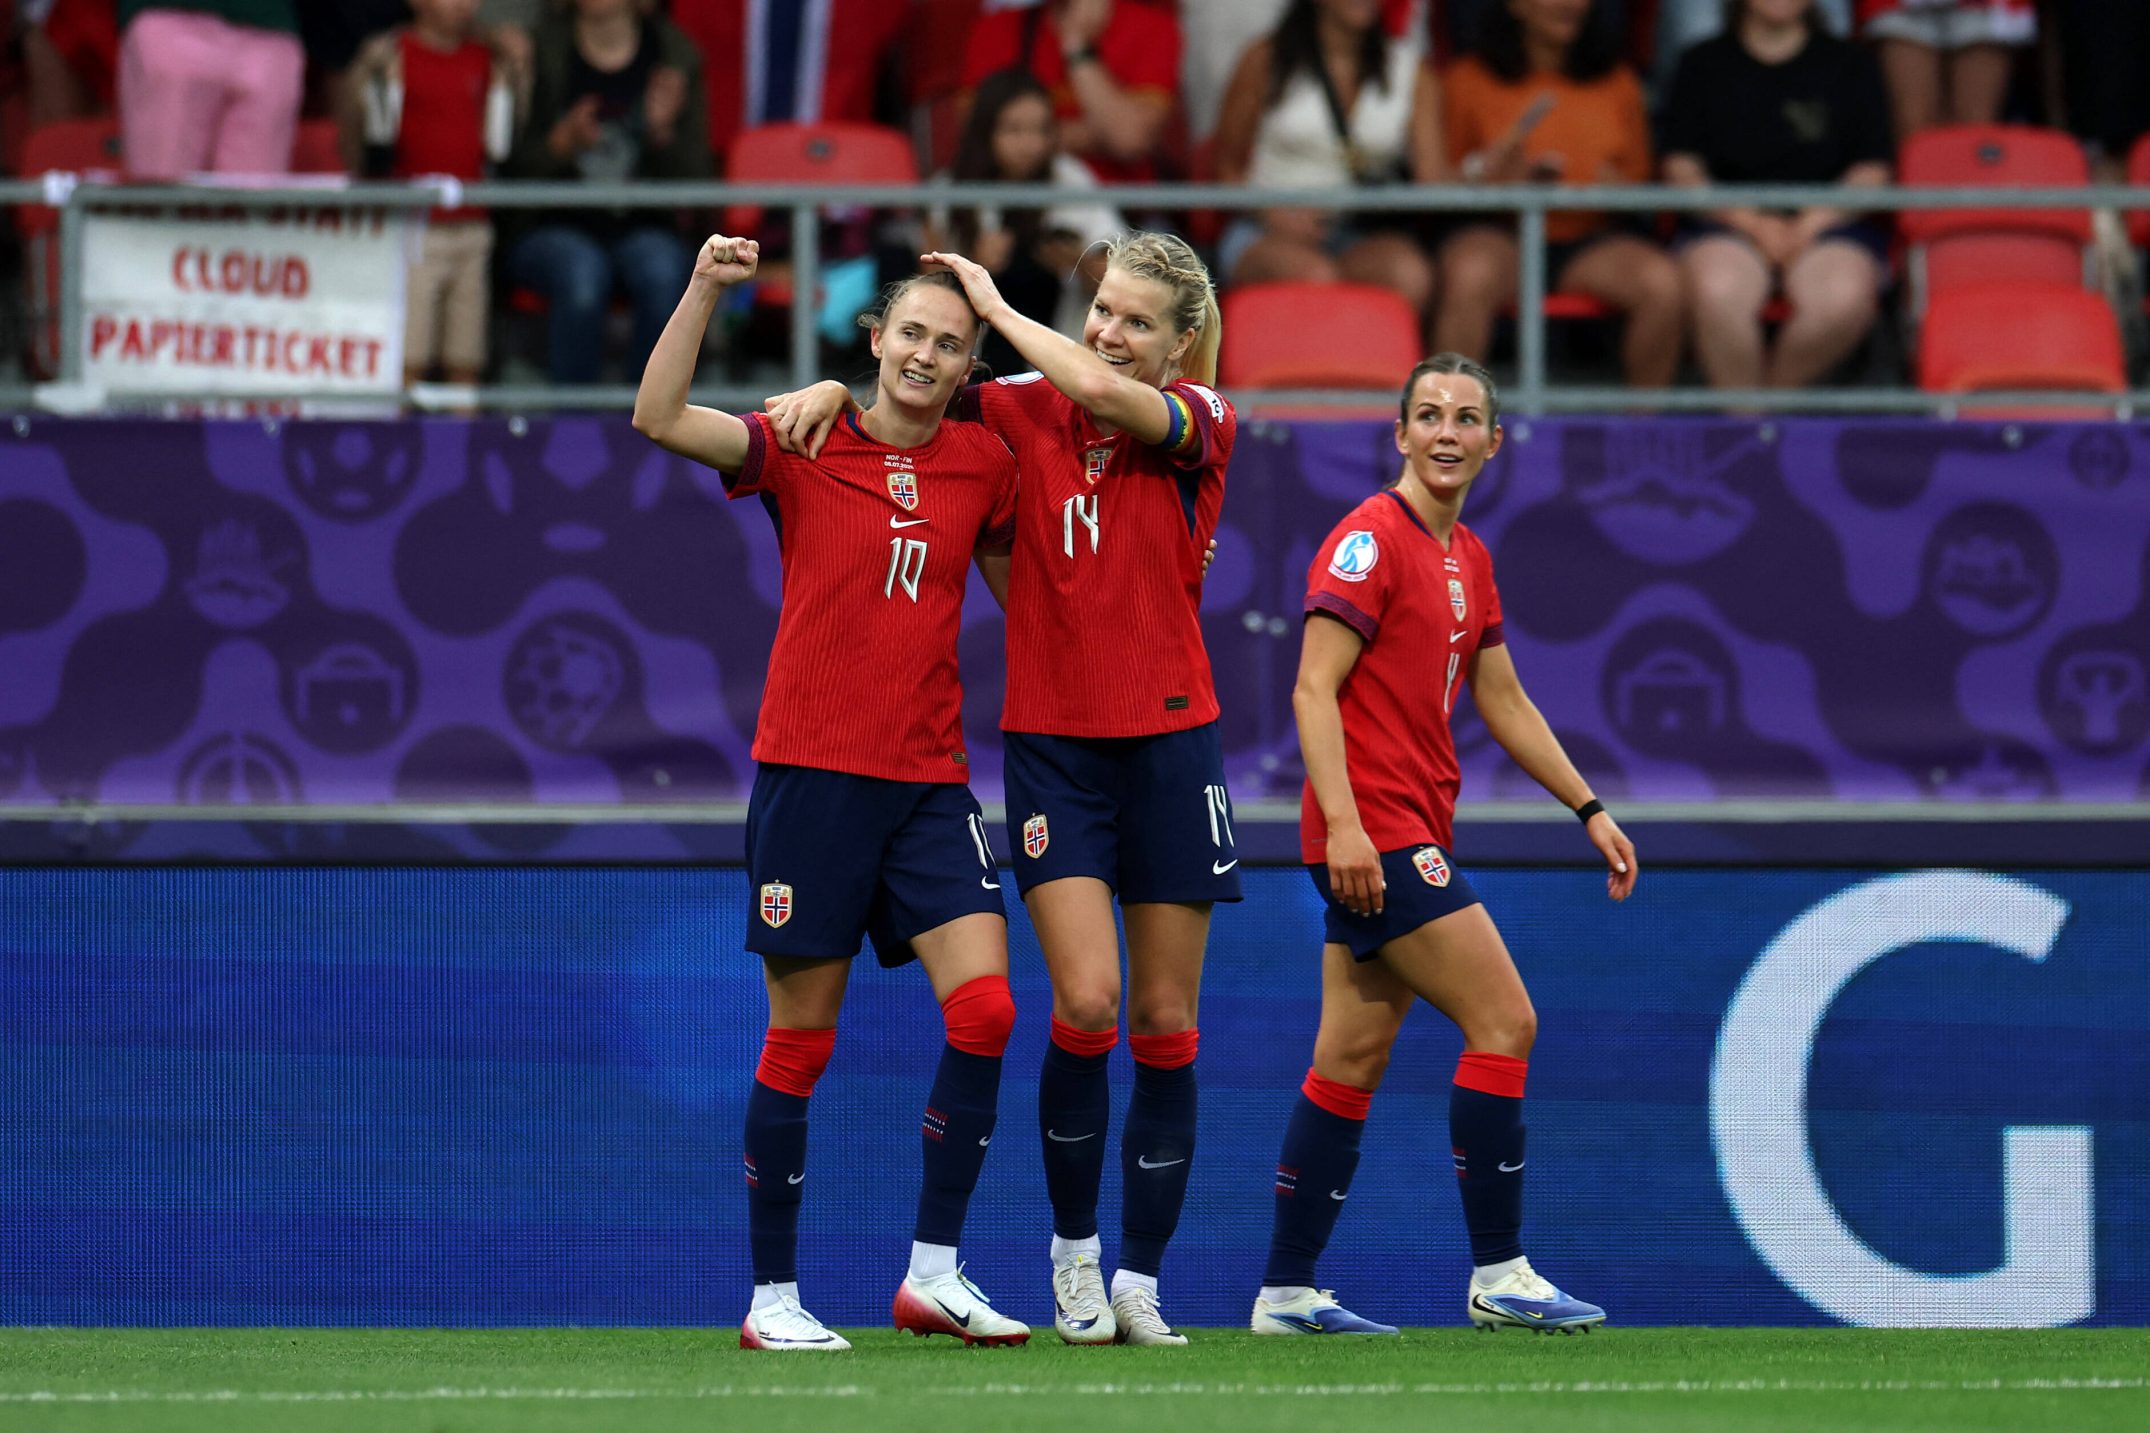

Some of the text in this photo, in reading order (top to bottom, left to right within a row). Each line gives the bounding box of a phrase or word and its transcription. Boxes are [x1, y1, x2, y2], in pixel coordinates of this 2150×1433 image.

[172, 246, 310, 299] CLOUD
[90, 315, 382, 378] PAPIERTICKET
[1063, 493, 1099, 560] 14
[884, 537, 928, 604] 10
[1204, 785, 1235, 848] 14
[1709, 867, 2096, 1329] G
